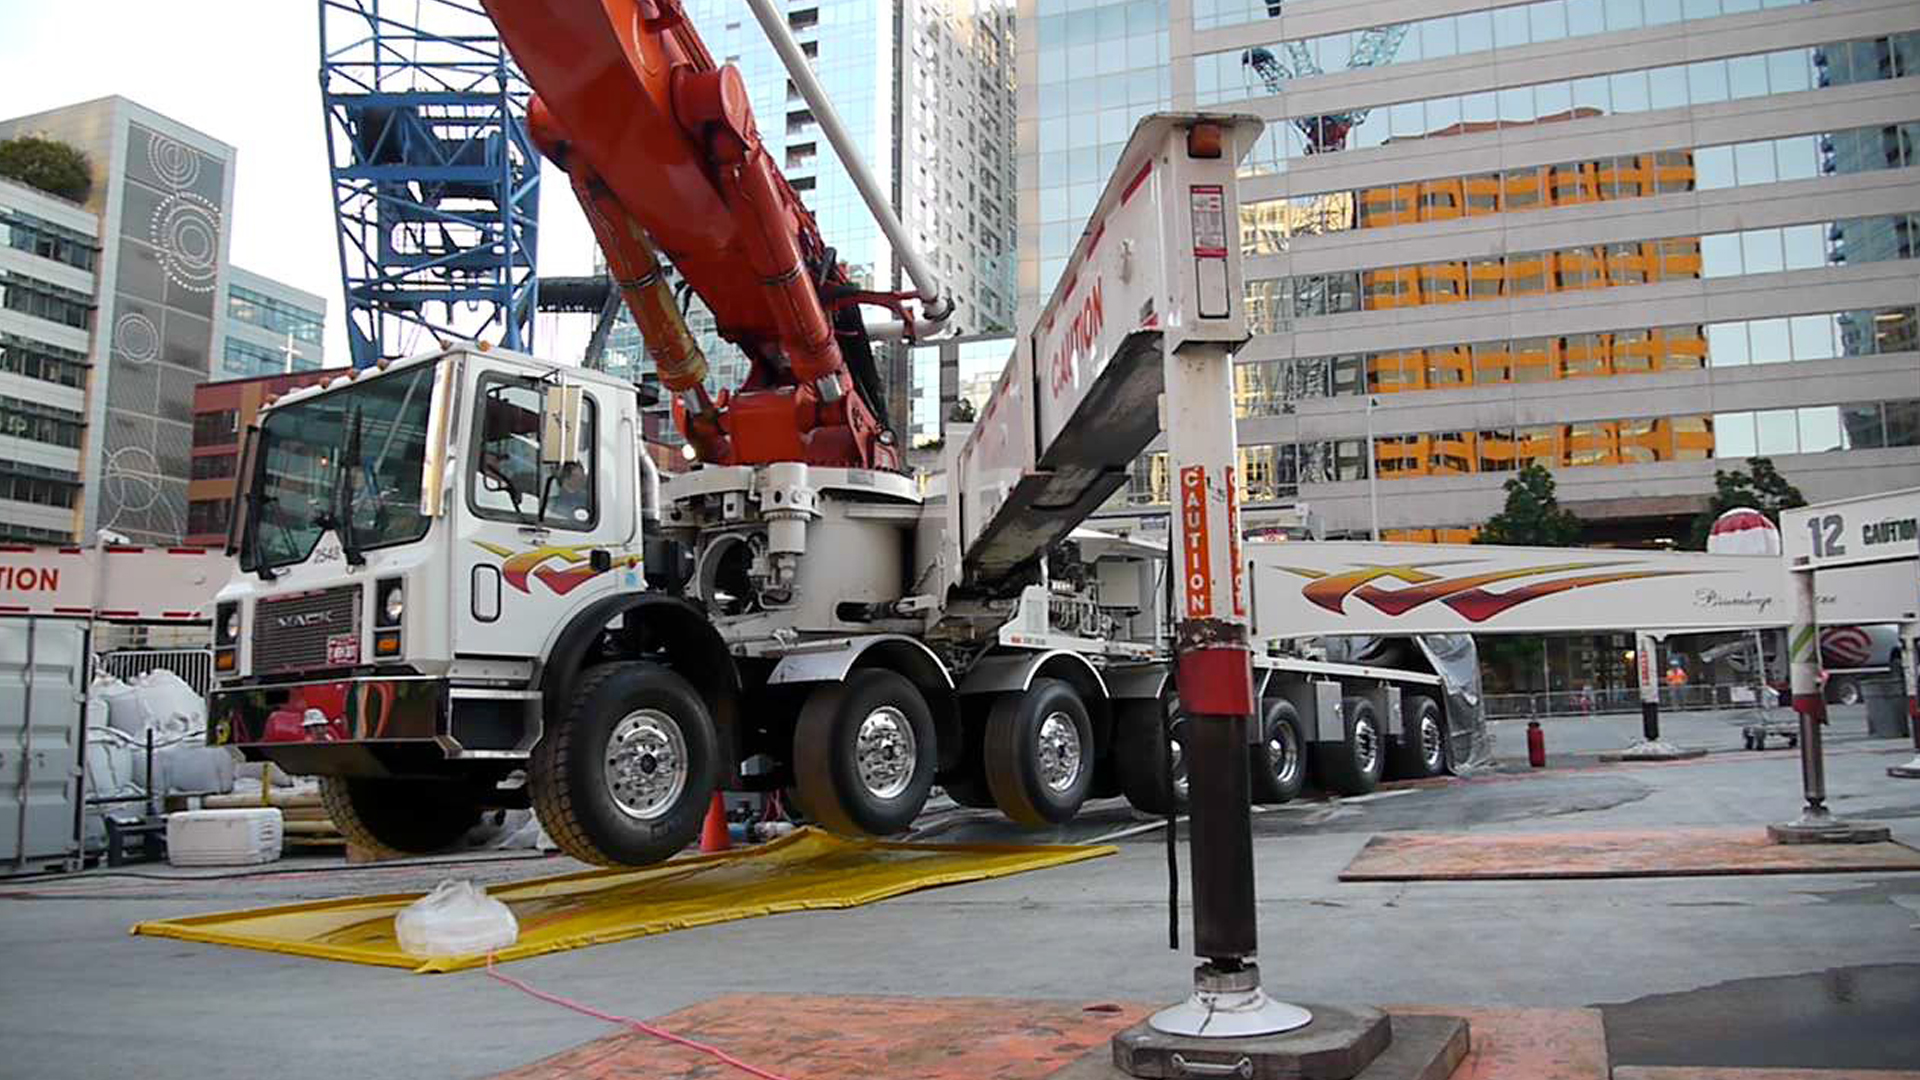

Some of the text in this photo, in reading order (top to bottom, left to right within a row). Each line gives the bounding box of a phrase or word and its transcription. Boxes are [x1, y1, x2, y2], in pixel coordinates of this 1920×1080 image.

[1051, 275, 1103, 399] CAUTION
[1184, 471, 1205, 611] CAUTION
[1807, 514, 1845, 558] 12
